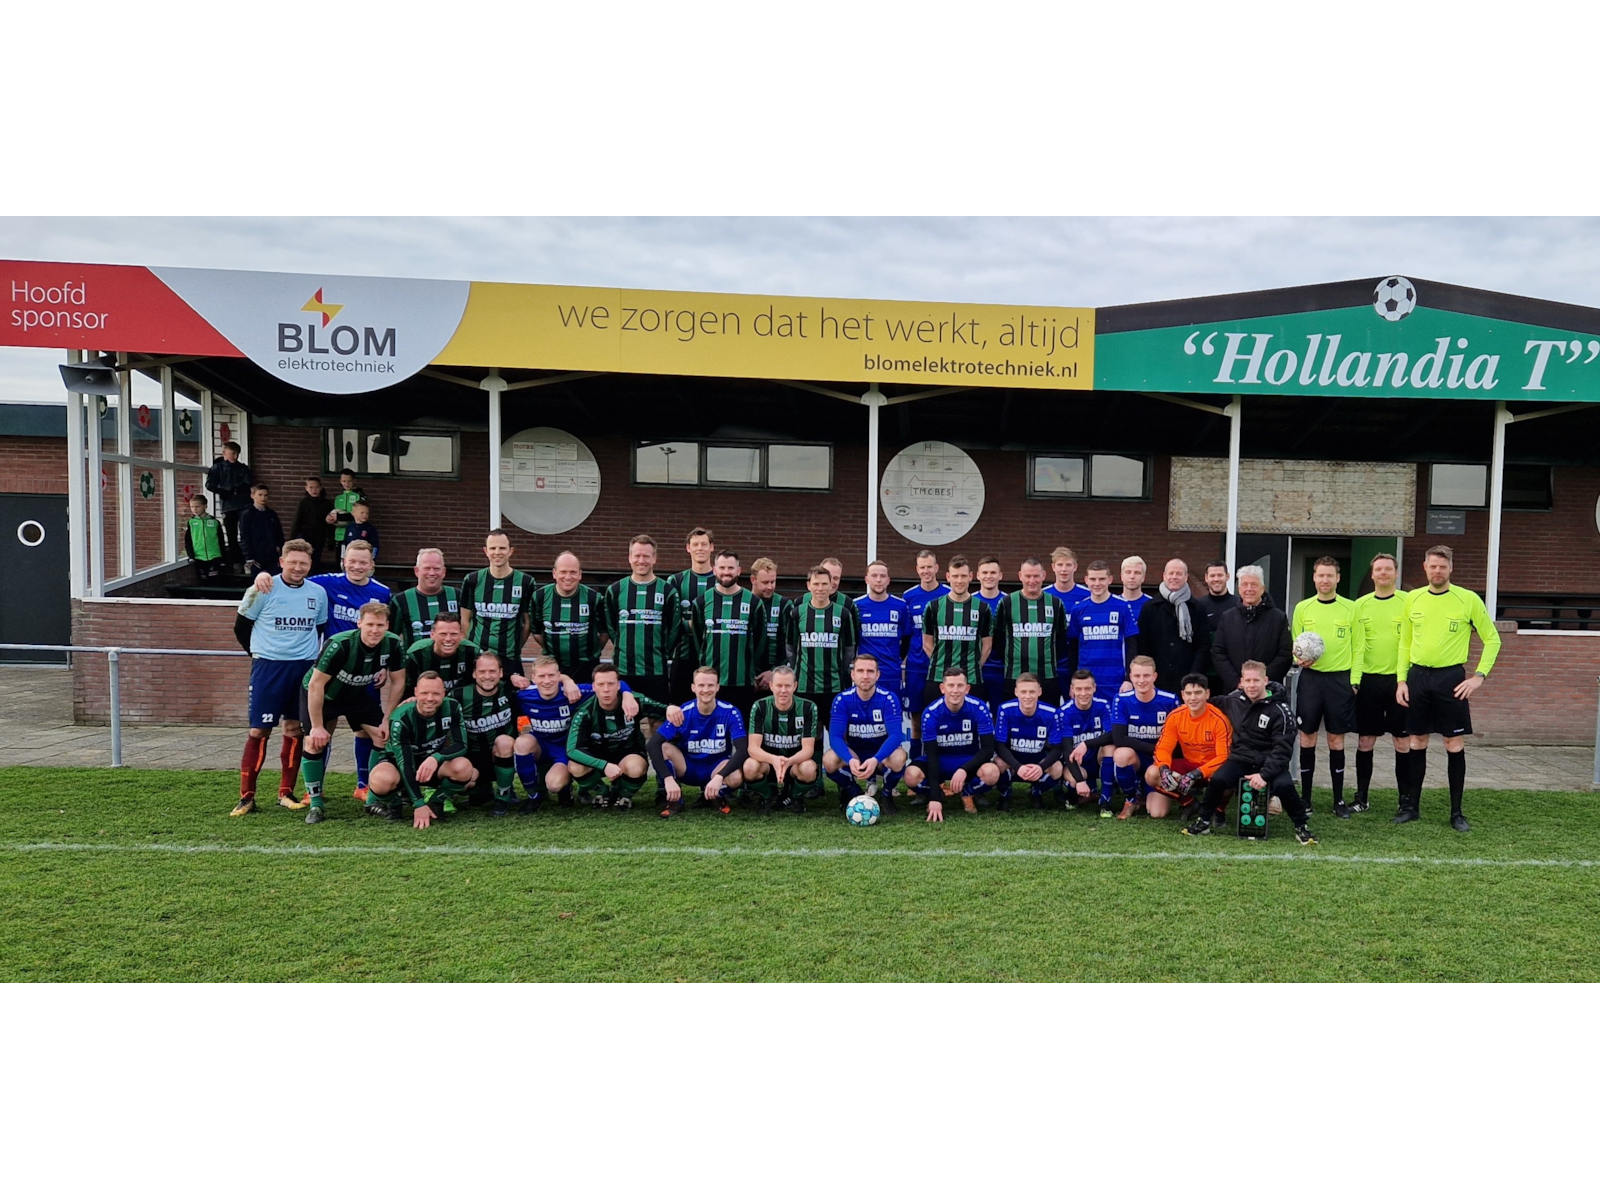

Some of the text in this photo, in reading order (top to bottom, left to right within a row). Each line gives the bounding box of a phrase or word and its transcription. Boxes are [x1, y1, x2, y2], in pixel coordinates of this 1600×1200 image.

[11, 279, 86, 306] Hoofd
[11, 306, 108, 331] sponsor
[558, 304, 1079, 356] we zorgen dat het werkt, altijd
[277, 323, 396, 357] BLOM
[277, 357, 396, 374] elektrotechniek
[864, 354, 1078, 378] blomelektrotechniek.nl
[475, 602, 506, 612] BLOM
[275, 617, 309, 627] BLOM
[862, 623, 889, 633] BLOM
[937, 625, 967, 635] BLOM
[1013, 623, 1043, 633] BLOM
[1083, 625, 1110, 635] BLOM
[800, 632, 830, 643] BLOM
[262, 714, 274, 723] 22
[531, 718, 561, 730] BLOM
[849, 724, 877, 734] BLOM
[1128, 724, 1157, 736] BLOM
[688, 739, 714, 750] BLOM
